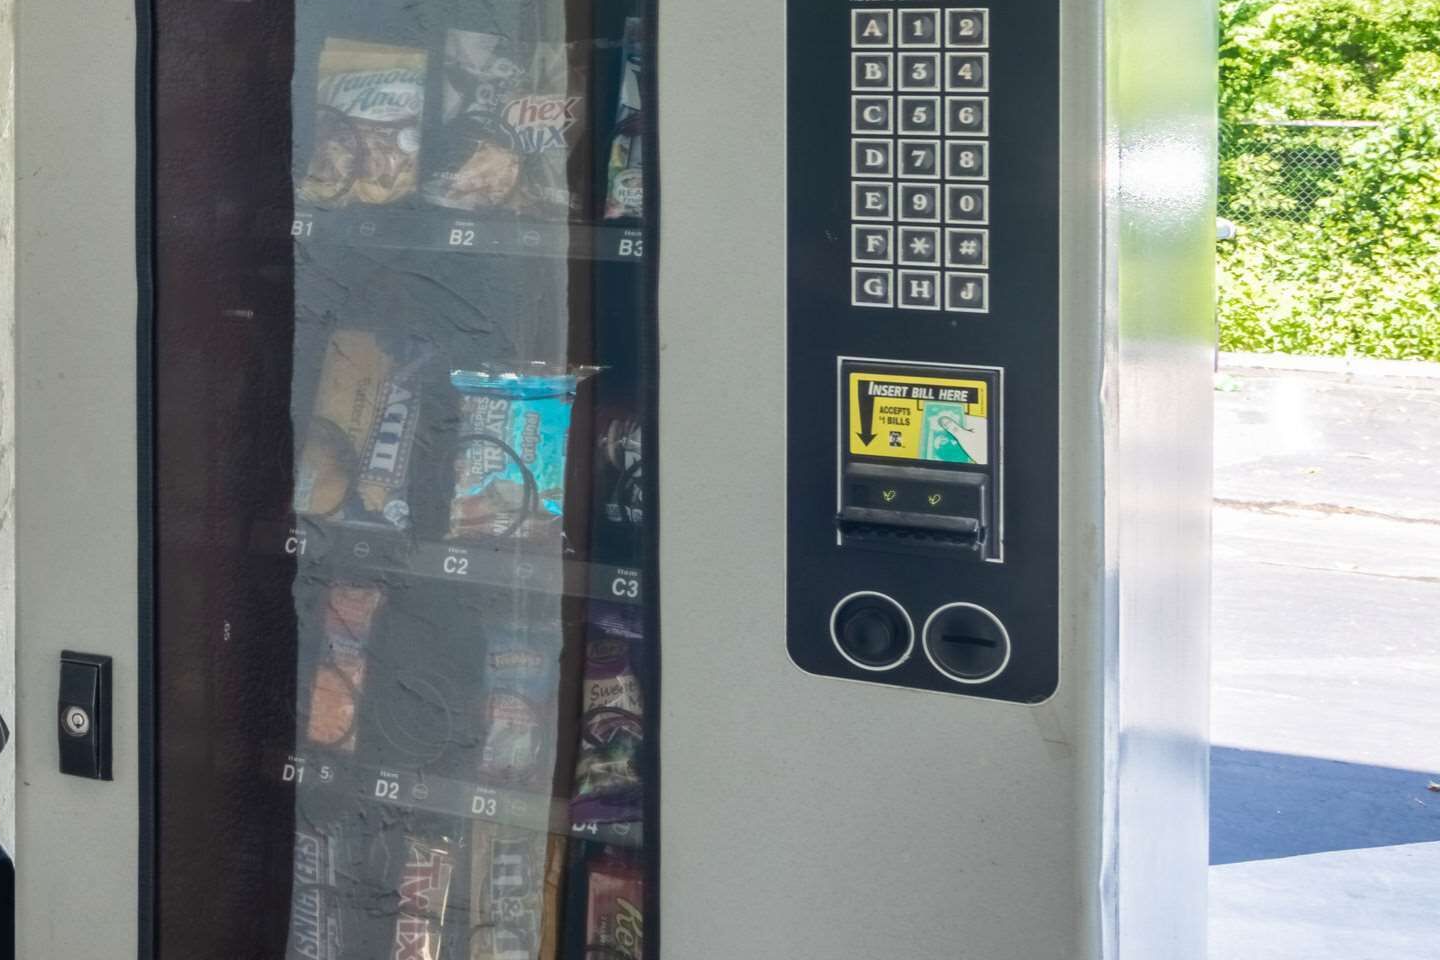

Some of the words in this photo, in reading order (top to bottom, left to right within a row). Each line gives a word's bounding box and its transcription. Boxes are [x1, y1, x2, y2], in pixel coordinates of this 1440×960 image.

[862, 19, 882, 37] A
[912, 19, 923, 36] 1
[960, 19, 974, 36] 2
[864, 62, 882, 80] B
[912, 63, 927, 79] 3
[958, 63, 972, 80] 4
[863, 105, 882, 123] C
[912, 107, 927, 123] 5
[959, 107, 974, 124] 6
[865, 149, 884, 166] D
[911, 150, 926, 167] 7
[960, 151, 974, 168] 8
[865, 192, 882, 209] E
[912, 193, 927, 211] 9
[960, 195, 974, 211] 0
[290, 221, 312, 237] B1
[449, 230, 475, 246] B2
[866, 235, 883, 252] F
[619, 241, 643, 257] B3
[863, 278, 883, 296] G
[910, 280, 930, 298] H
[961, 283, 975, 300] J
[868, 381, 908, 397] INSERT
[912, 387, 934, 399] BILL
[938, 389, 968, 402] HERE
[879, 406, 910, 416] ACCEPTS
[472, 397, 490, 448] KISPIES
[887, 417, 910, 426] BILLS
[484, 397, 508, 474] TRATS
[284, 537, 307, 555] C1
[443, 556, 469, 575] C2
[612, 578, 639, 597] C3
[282, 764, 304, 783] D1
[374, 780, 400, 800] D2
[471, 797, 498, 816] D3
